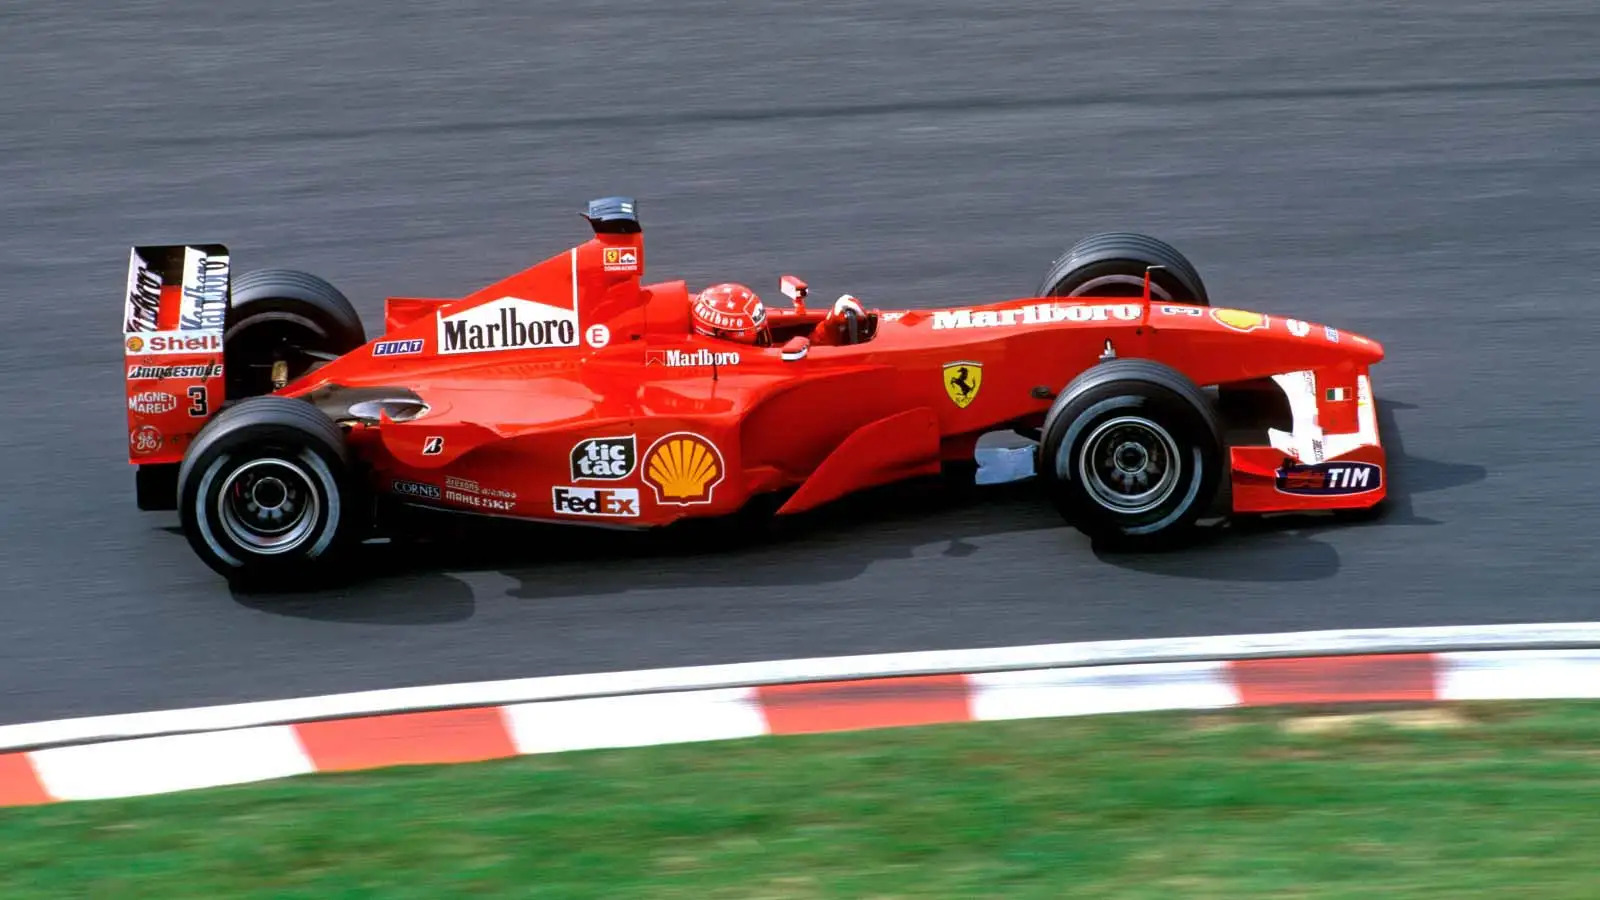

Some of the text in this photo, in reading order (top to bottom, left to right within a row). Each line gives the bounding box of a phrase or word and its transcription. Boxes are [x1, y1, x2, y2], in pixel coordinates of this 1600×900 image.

[932, 303, 1143, 330] Marlboro
[443, 308, 575, 351] Marlboro
[592, 329, 604, 343] E
[149, 336, 220, 351] Shell
[376, 340, 421, 354] FIAT
[666, 349, 740, 367] Marlboro
[128, 365, 223, 379] BRIDGESTONE
[187, 386, 208, 417] 3
[585, 441, 625, 460] tic
[577, 456, 626, 475] tac
[1328, 467, 1371, 488] TIM
[394, 481, 440, 498] CORNES
[554, 488, 637, 515] FedEx
